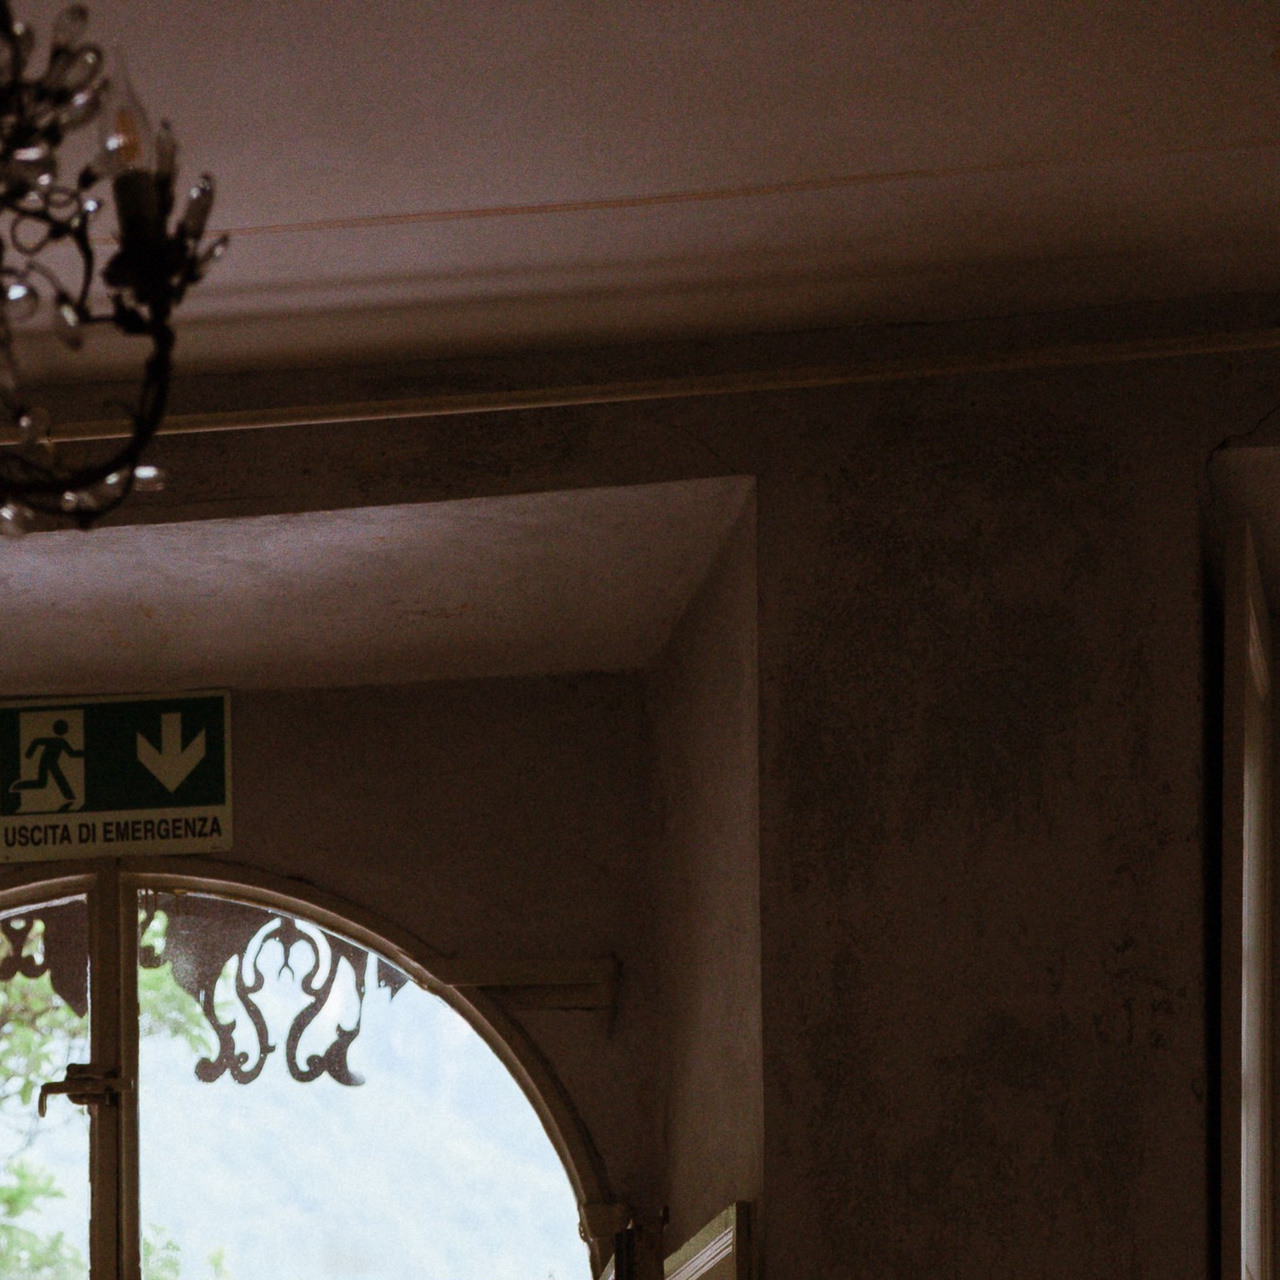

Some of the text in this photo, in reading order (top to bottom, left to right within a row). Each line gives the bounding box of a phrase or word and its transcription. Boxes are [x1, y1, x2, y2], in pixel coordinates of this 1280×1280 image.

[4, 817, 222, 847] USCITA DI EMERGENZA
